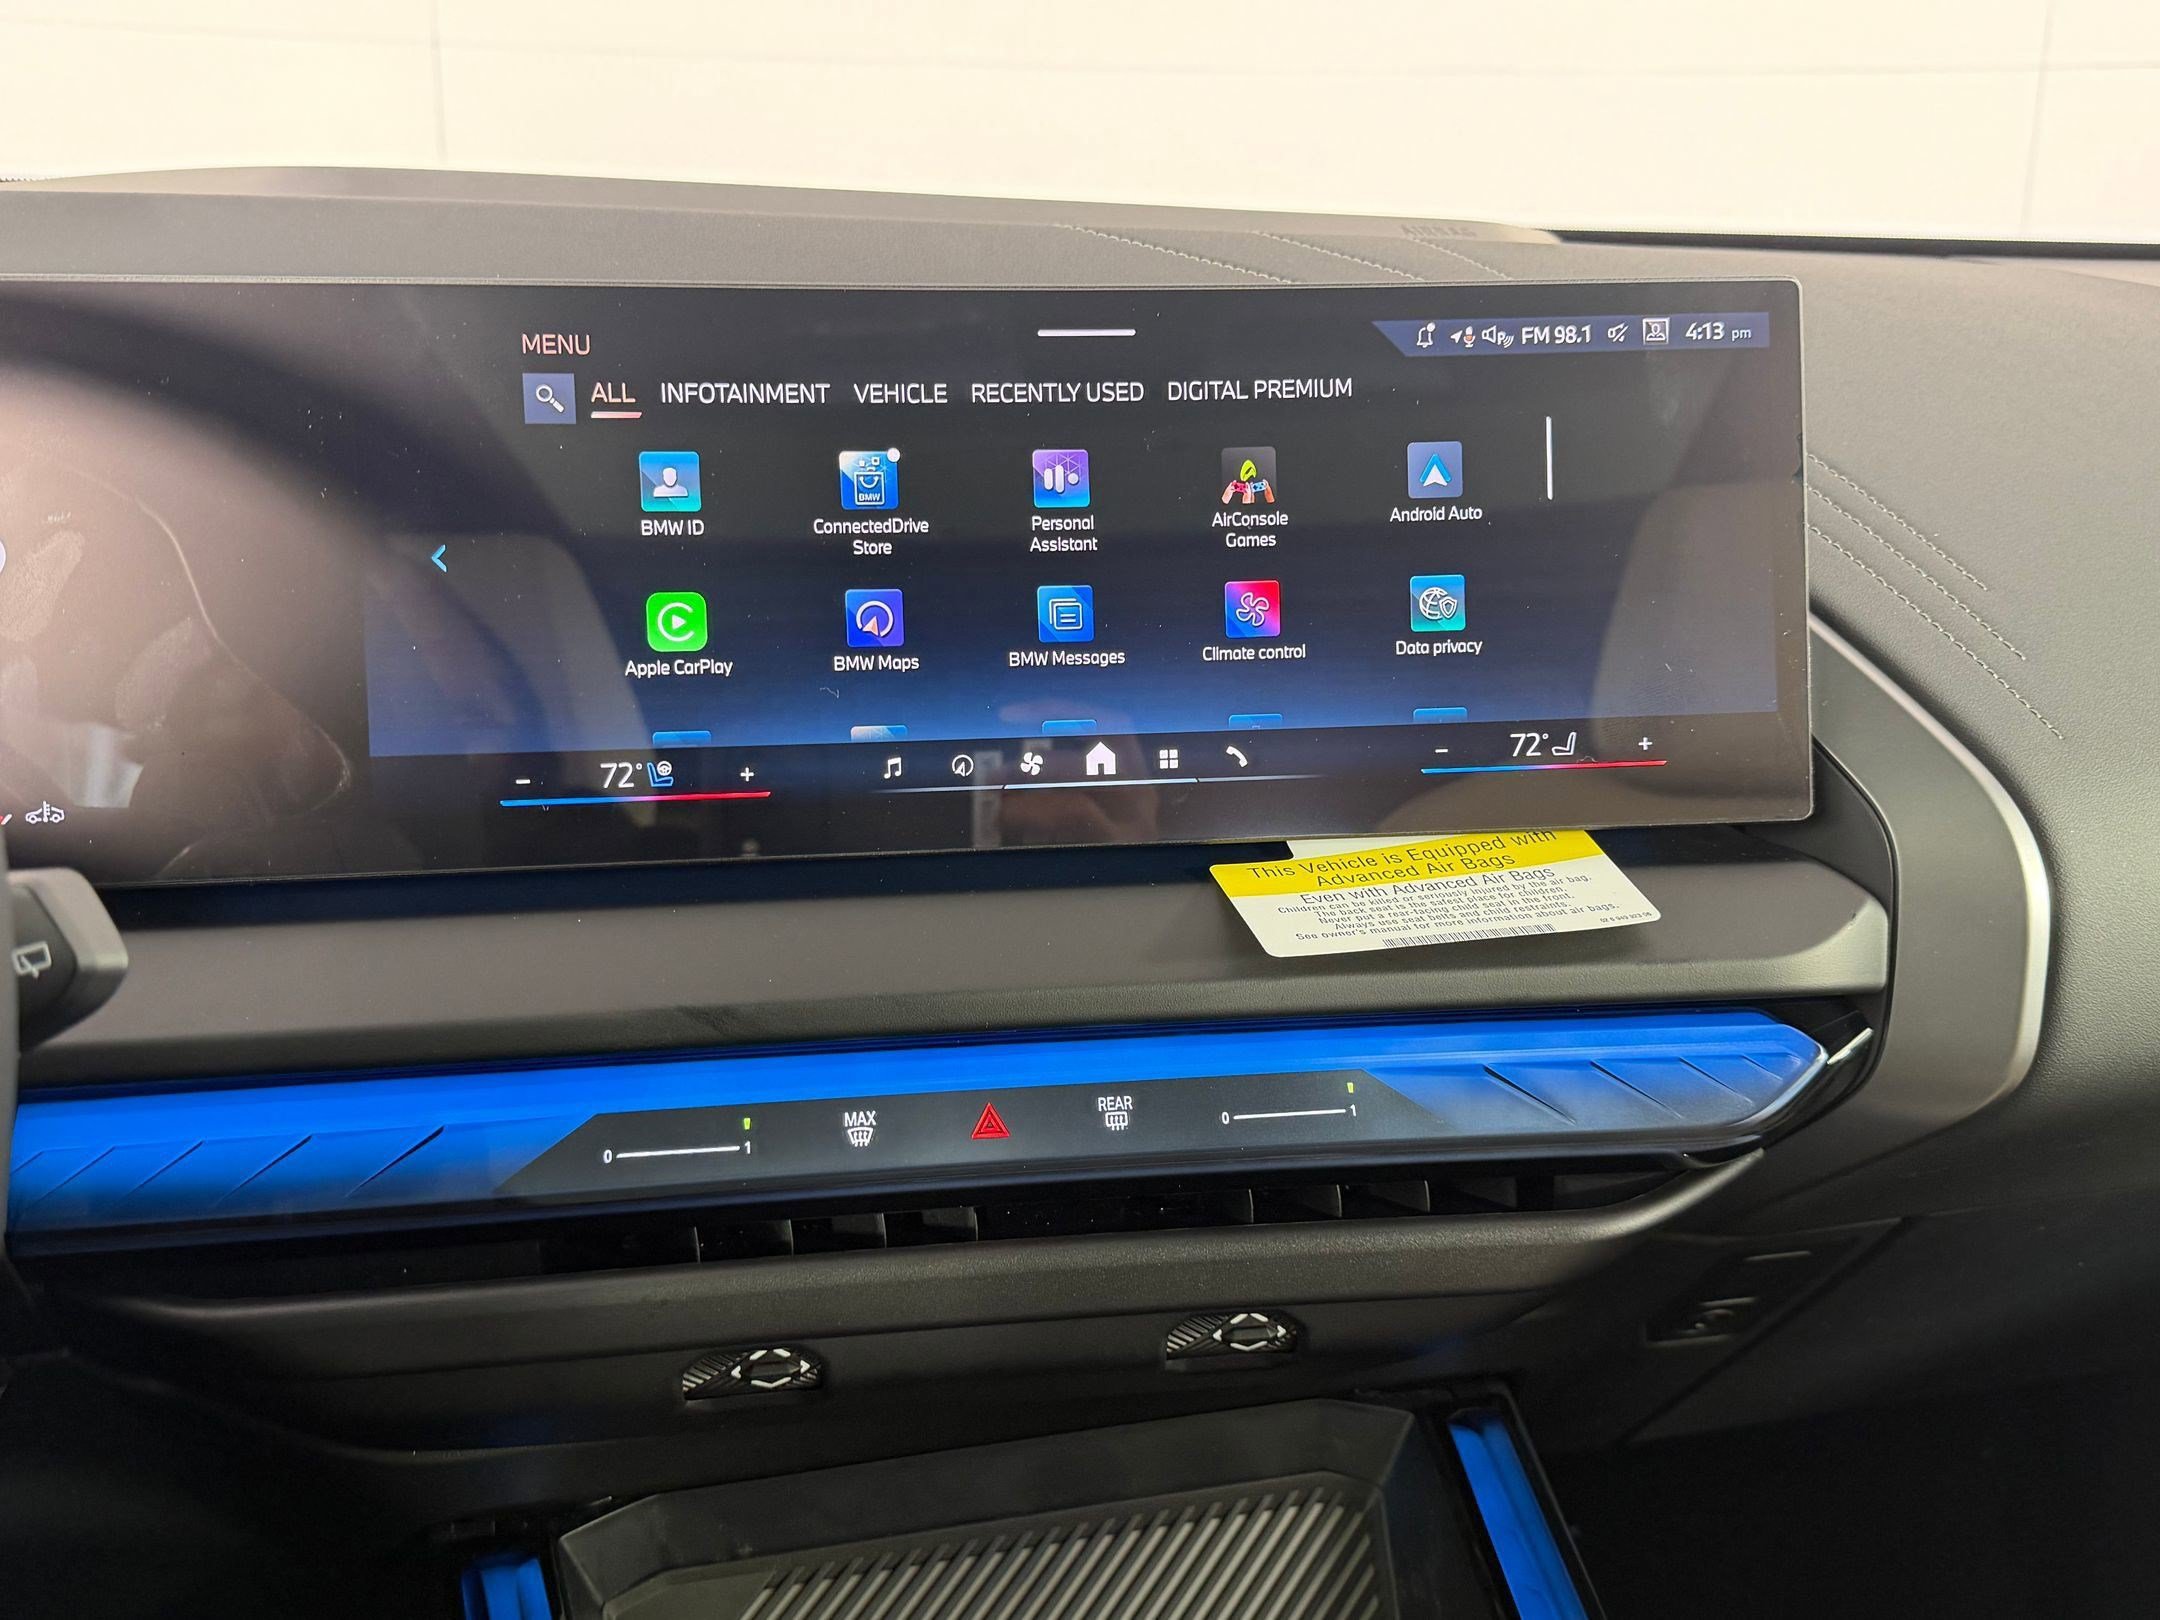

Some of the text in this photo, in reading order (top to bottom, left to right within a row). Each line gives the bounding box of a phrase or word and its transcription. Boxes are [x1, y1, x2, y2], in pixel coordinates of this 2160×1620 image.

[1521, 324, 1592, 345] FM 98.1
[1685, 321, 1752, 342] 4:13 pm
[522, 334, 591, 355] MENU
[591, 377, 1353, 404] ALL INFOTAINMENT VEHICLE RECENTLY USED DIGITAL PREMIUM
[858, 492, 881, 503] BMW
[1031, 515, 1094, 531] Personal
[1211, 511, 1289, 528] AirConsole
[1389, 505, 1483, 522] Android Auto
[641, 519, 705, 537] BMW ID
[813, 518, 929, 535] ConnectedDrive
[853, 539, 892, 556] Store
[1029, 536, 1098, 553] Assistant
[1225, 532, 1276, 549] Games
[1202, 643, 1306, 662] Climate control
[1395, 639, 1483, 657] Data privacy
[625, 658, 733, 678] Apple CarPlay
[833, 654, 920, 672] BMW Maps
[1009, 649, 1126, 668] BMW Messages
[1510, 732, 1549, 757] 72°
[600, 761, 643, 789] 72°
[1247, 830, 1557, 879] This Vehicle is Equipped with
[1317, 854, 1516, 887] Advanced Air Bags
[1277, 904, 1326, 914] Children
[1370, 896, 1399, 906] killed
[1417, 889, 1468, 900] seriously
[1470, 884, 1510, 896] injured
[1512, 882, 1526, 891] by
[1528, 880, 1547, 888] the
[1549, 877, 1563, 886] air
[1566, 874, 1592, 883] bag.
[1300, 868, 1555, 904] Even with Advanced Air Bags
[1313, 911, 1337, 919] The
[1339, 907, 1367, 916] back
[1409, 900, 1427, 908] the
[1430, 896, 1464, 906] safest
[1466, 894, 1497, 904] place
[1498, 891, 1515, 899] for
[1518, 886, 1568, 897] children.
[1318, 915, 1352, 924] Never
[1356, 913, 1375, 921] put
[1388, 905, 1449, 918] rear-facing
[1452, 902, 1479, 912] child
[1482, 900, 1507, 908] seat
[1521, 895, 1541, 903] the
[1542, 892, 1575, 901] front.
[1295, 902, 1620, 940] See owner's manual for more information about air bags.
[1335, 921, 1375, 930] Always
[1401, 915, 1426, 923] seat
[1428, 912, 1457, 921] belts
[1459, 910, 1480, 918] and
[1483, 907, 1511, 916] child
[1513, 900, 1572, 913] restraints.
[1097, 1095, 1133, 1111] REAR
[844, 1110, 877, 1128] MAX
[1221, 1104, 1357, 1125] 0 1
[603, 1141, 752, 1164] 0 1
